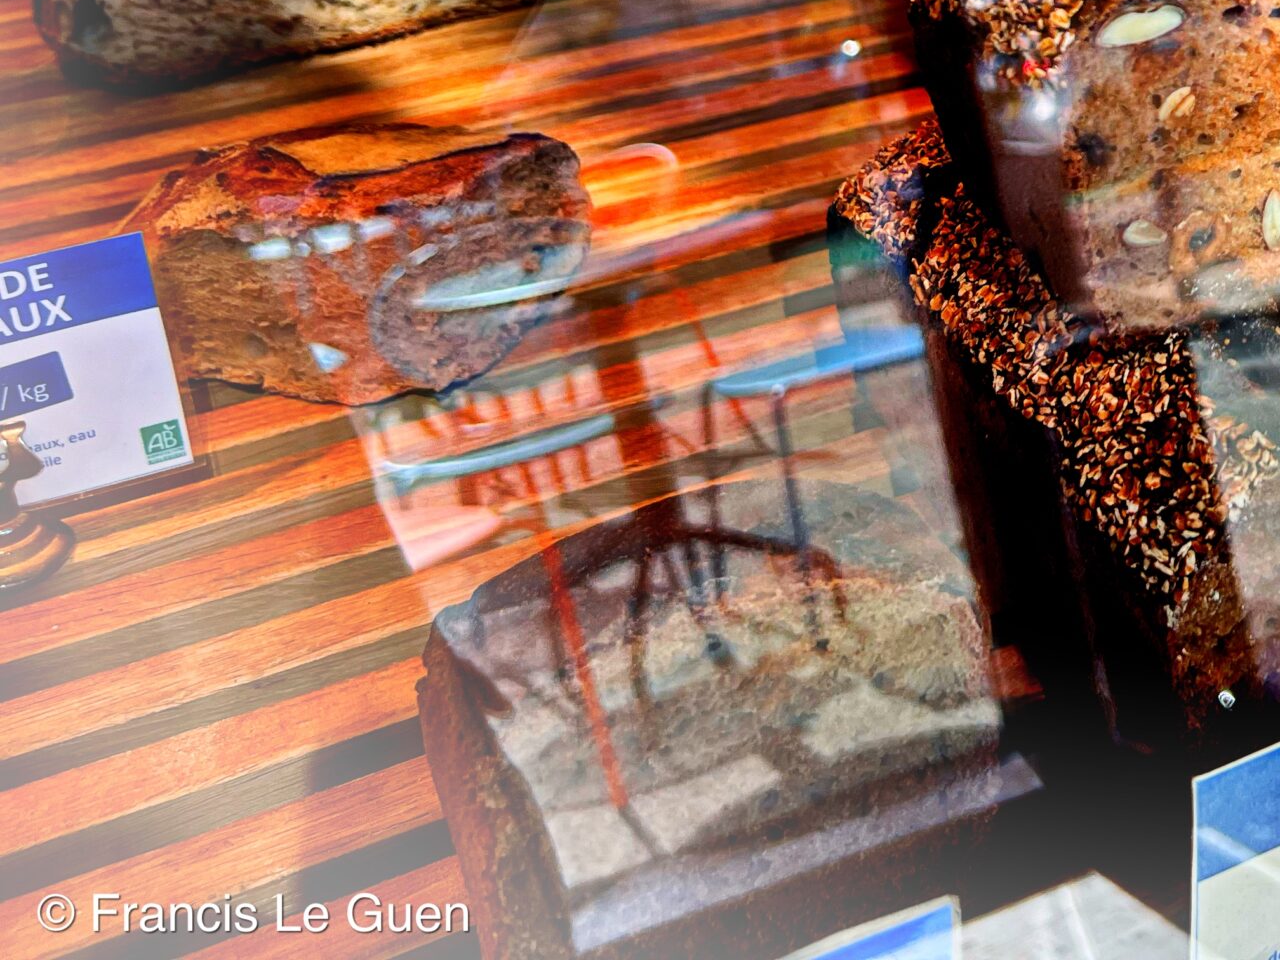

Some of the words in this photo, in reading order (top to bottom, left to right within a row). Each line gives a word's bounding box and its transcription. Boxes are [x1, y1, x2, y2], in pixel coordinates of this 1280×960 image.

[0, 262, 54, 300] DE
[17, 383, 50, 402] kg
[68, 429, 96, 443] eau
[147, 430, 178, 453] AB
